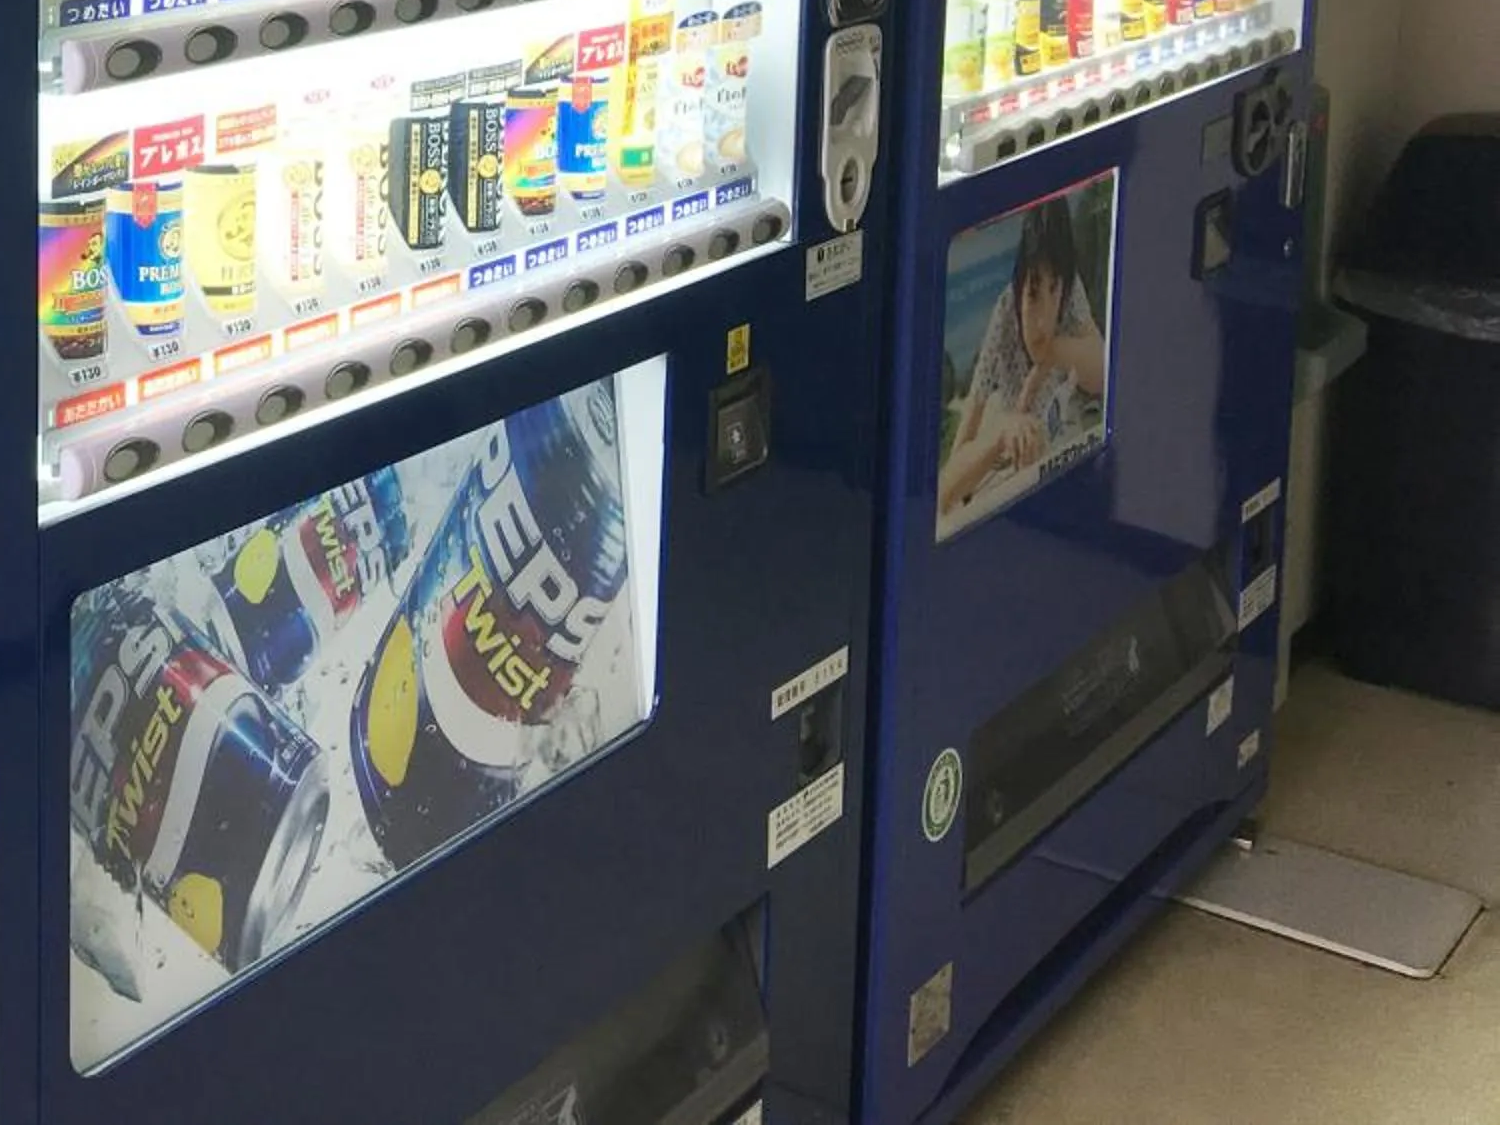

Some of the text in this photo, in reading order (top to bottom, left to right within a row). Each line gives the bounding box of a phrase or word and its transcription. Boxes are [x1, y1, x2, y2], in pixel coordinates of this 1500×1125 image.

[427, 121, 442, 169] BOSS
[484, 107, 499, 153] BOSS
[151, 342, 180, 359] ¥130
[73, 366, 102, 383] ¥130
[62, 392, 122, 424] あたたかい
[312, 500, 356, 602] Twist
[451, 546, 554, 709] Twist
[106, 685, 183, 863] Twist
